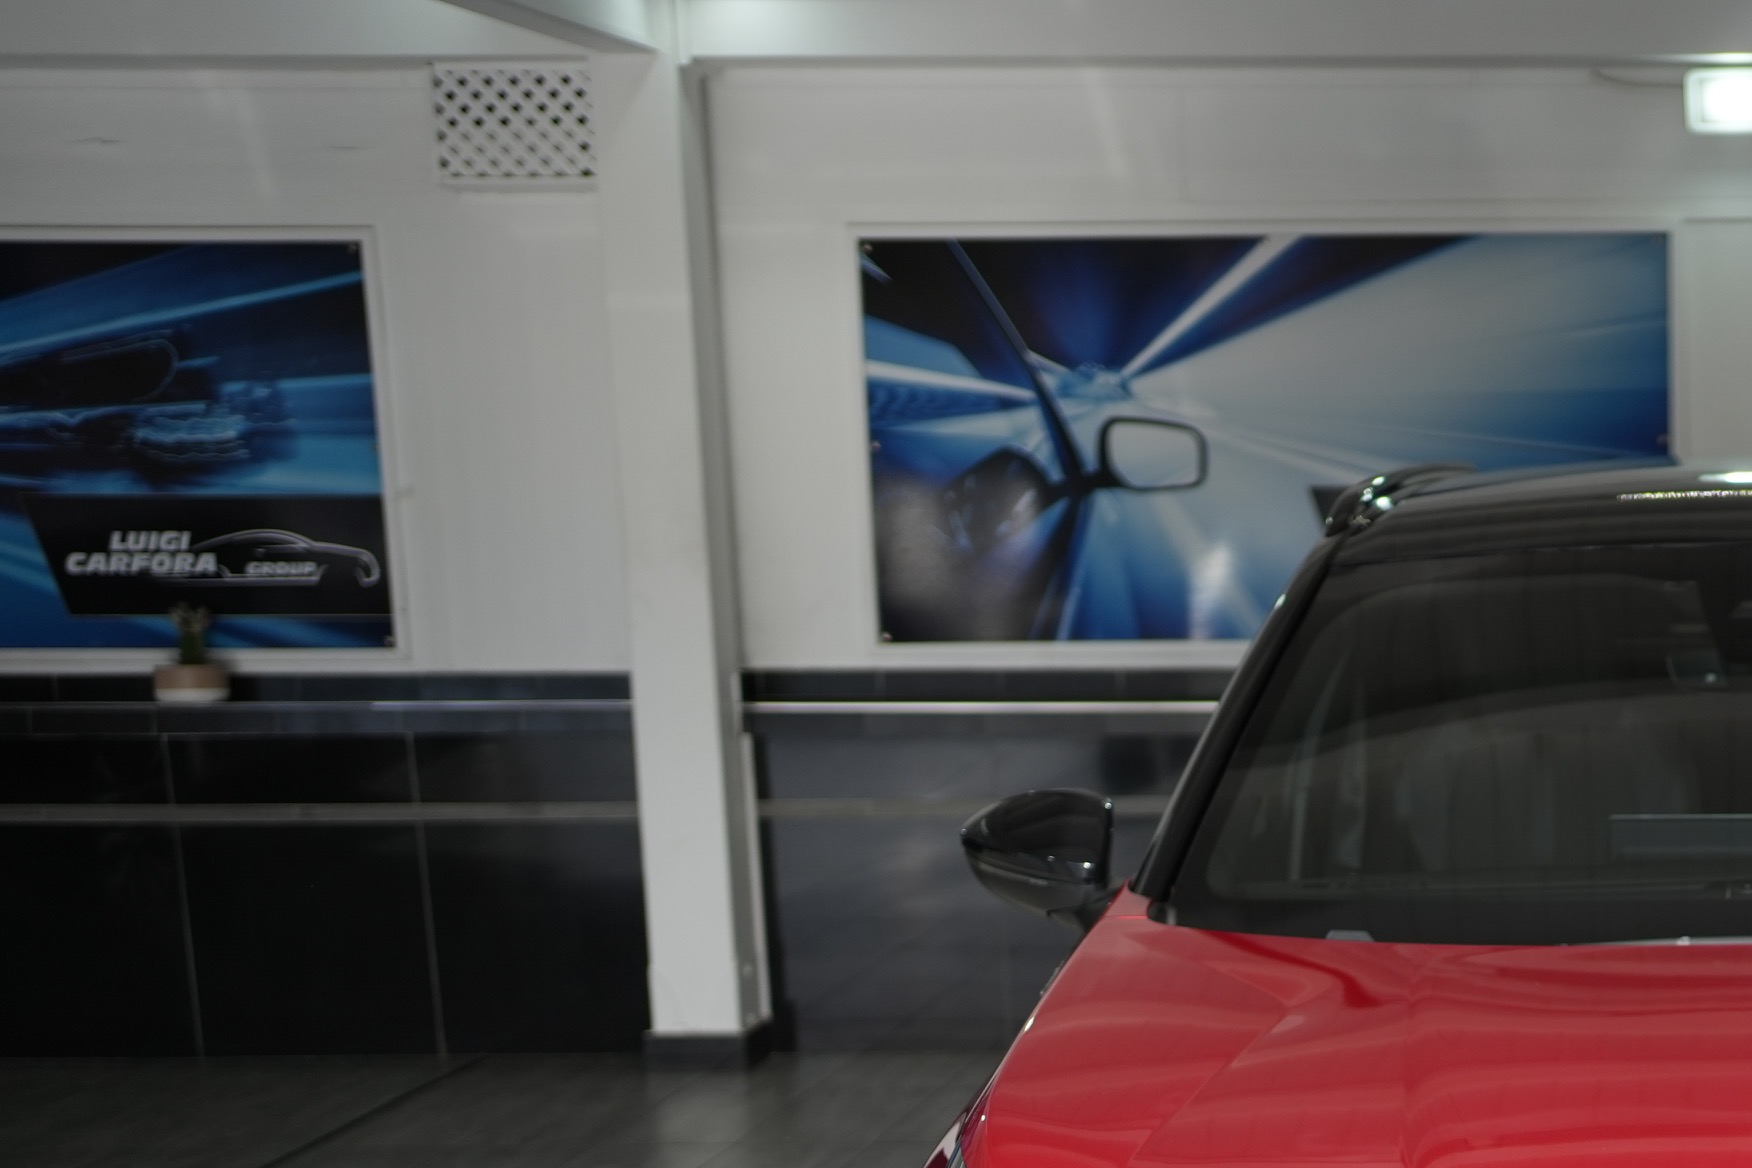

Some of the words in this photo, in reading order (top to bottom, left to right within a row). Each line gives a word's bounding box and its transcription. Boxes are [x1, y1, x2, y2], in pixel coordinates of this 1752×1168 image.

[109, 531, 191, 552] LUIGI
[66, 553, 218, 577] CARFORA
[245, 561, 317, 576] GROUP
